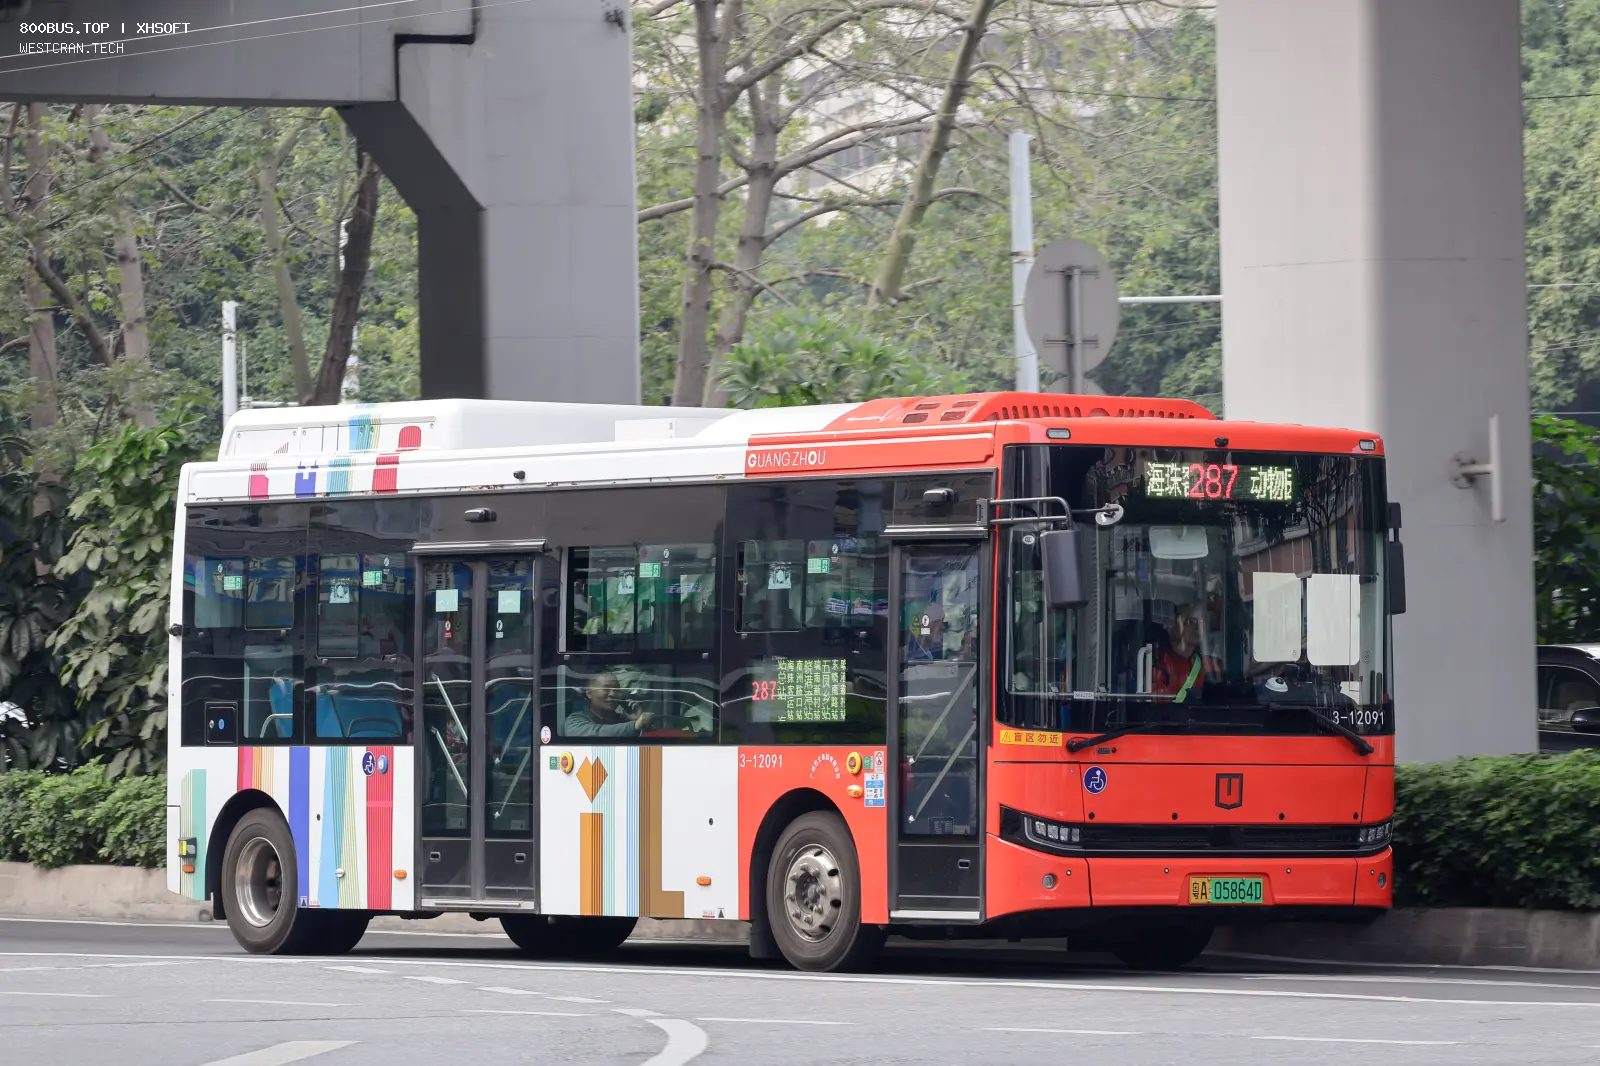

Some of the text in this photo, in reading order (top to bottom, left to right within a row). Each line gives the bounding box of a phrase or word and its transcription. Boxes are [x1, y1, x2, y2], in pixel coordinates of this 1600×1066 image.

[748, 450, 826, 468] GUANGZHOU
[1189, 464, 1238, 498] 287
[752, 681, 776, 701] 287
[1332, 711, 1384, 724] 3-12091
[1014, 732, 1059, 744] 盲区勿近
[740, 754, 782, 768] 3-12091
